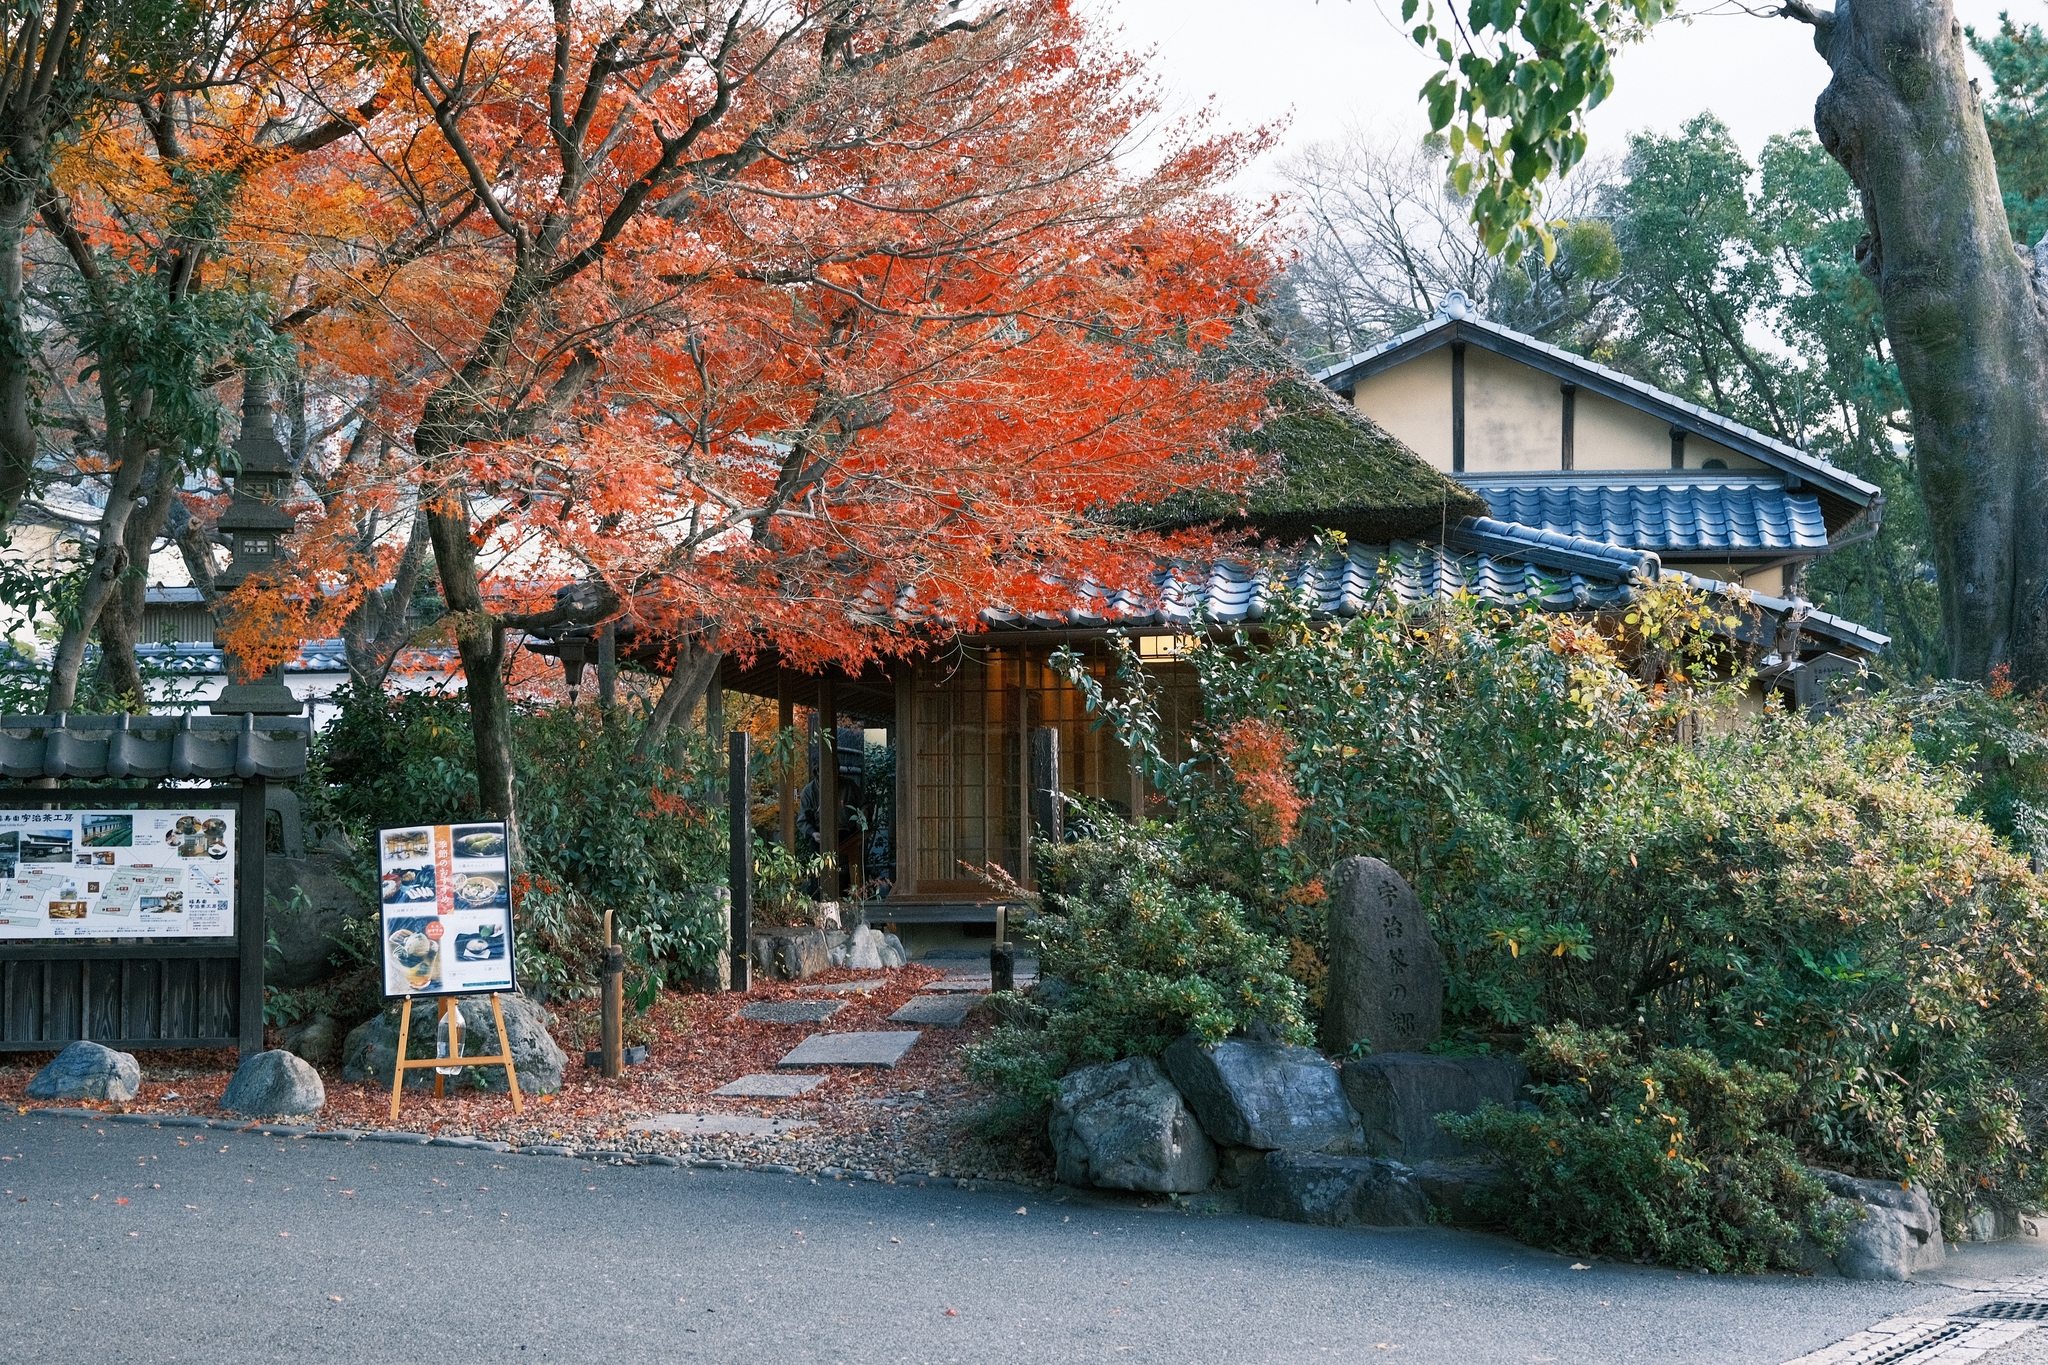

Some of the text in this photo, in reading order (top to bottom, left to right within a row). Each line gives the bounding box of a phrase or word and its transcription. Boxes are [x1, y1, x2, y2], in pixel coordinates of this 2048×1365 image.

[437, 840, 450, 903] 季節のおすすめ
[1378, 880, 1415, 1036] 宇治茶の郷
